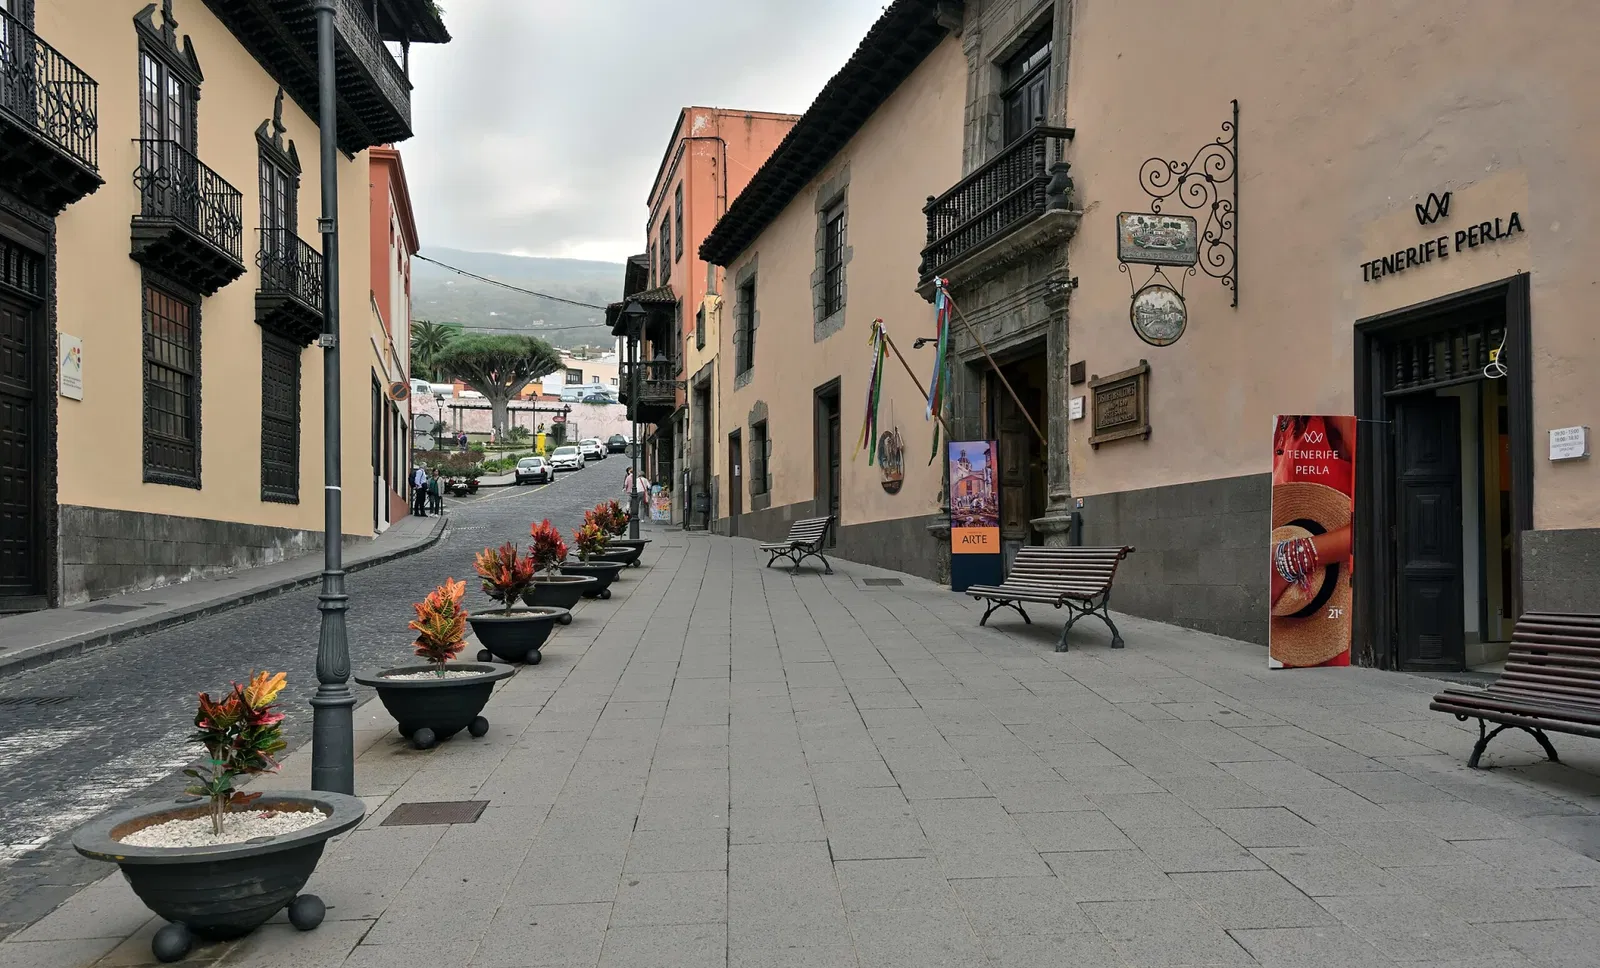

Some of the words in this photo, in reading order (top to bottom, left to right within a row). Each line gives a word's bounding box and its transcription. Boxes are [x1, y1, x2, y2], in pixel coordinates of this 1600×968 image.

[1360, 235, 1449, 282] TENERIFE
[1455, 211, 1524, 253] PERLA
[1287, 450, 1339, 460] TENERIFE
[1295, 465, 1330, 475] PERLA
[962, 534, 987, 544] ARTE
